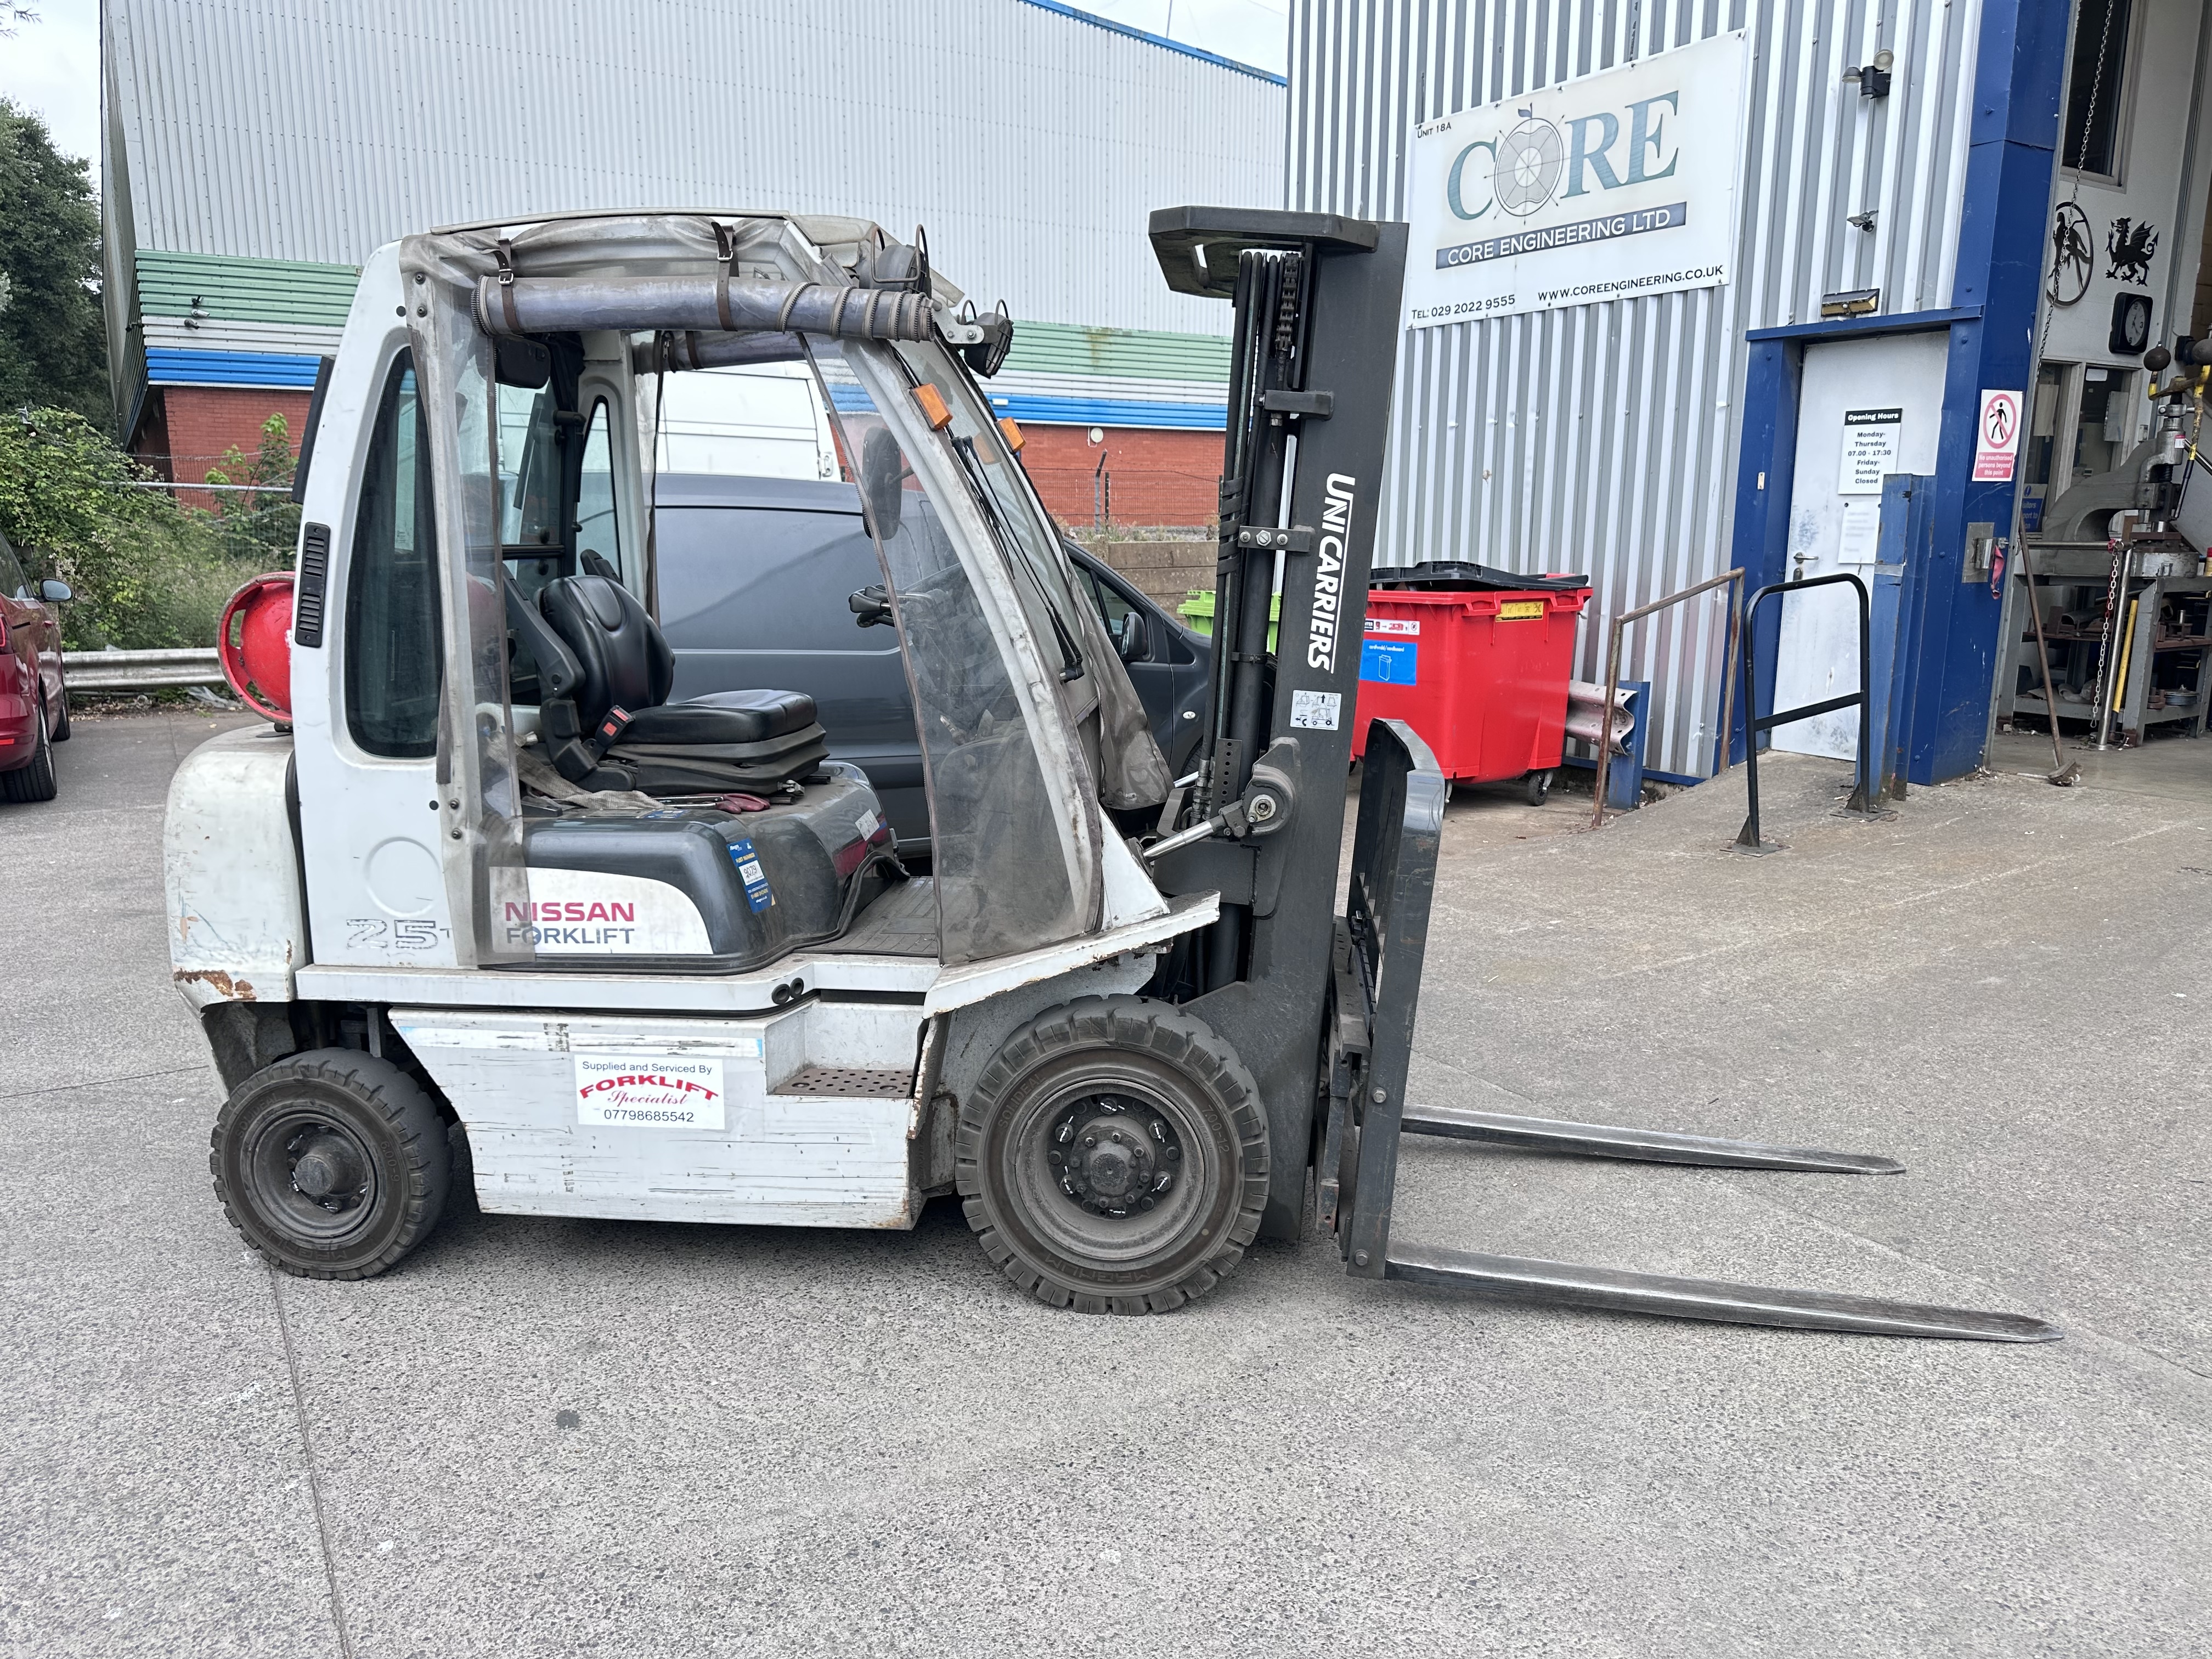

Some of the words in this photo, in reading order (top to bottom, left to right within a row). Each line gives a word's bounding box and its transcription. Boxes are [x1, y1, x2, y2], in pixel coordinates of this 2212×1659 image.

[1436, 122, 1452, 133] 18A
[1447, 91, 1679, 221] CORE
[1447, 241, 1494, 265] CORE
[1499, 217, 1626, 256] ENGINEERING
[1632, 208, 1671, 232] LTD
[1538, 264, 1724, 301] WWW.COREENGINEERING.CO.UK
[1431, 305, 1451, 317] 029
[1454, 301, 1482, 314] 2022
[1485, 294, 1516, 309] 9555
[1848, 413, 1876, 422] Opening
[1307, 472, 1356, 674] UNICARRIERS
[505, 902, 634, 922] NISSAN
[506, 926, 635, 946] FORKLIFT
[582, 1061, 626, 1071] Supplied
[629, 1063, 648, 1071] and
[651, 1063, 695, 1073] Serviced
[699, 1065, 712, 1075] By
[579, 1075, 719, 1101] FORKLIFT
[607, 1090, 688, 1107] Specialist
[998, 1074, 1047, 1129] SOLIDEAL
[603, 1109, 695, 1122] 07798685542
[1201, 1104, 1230, 1154] 7.00-12
[381, 1142, 400, 1182] 6.00-9
